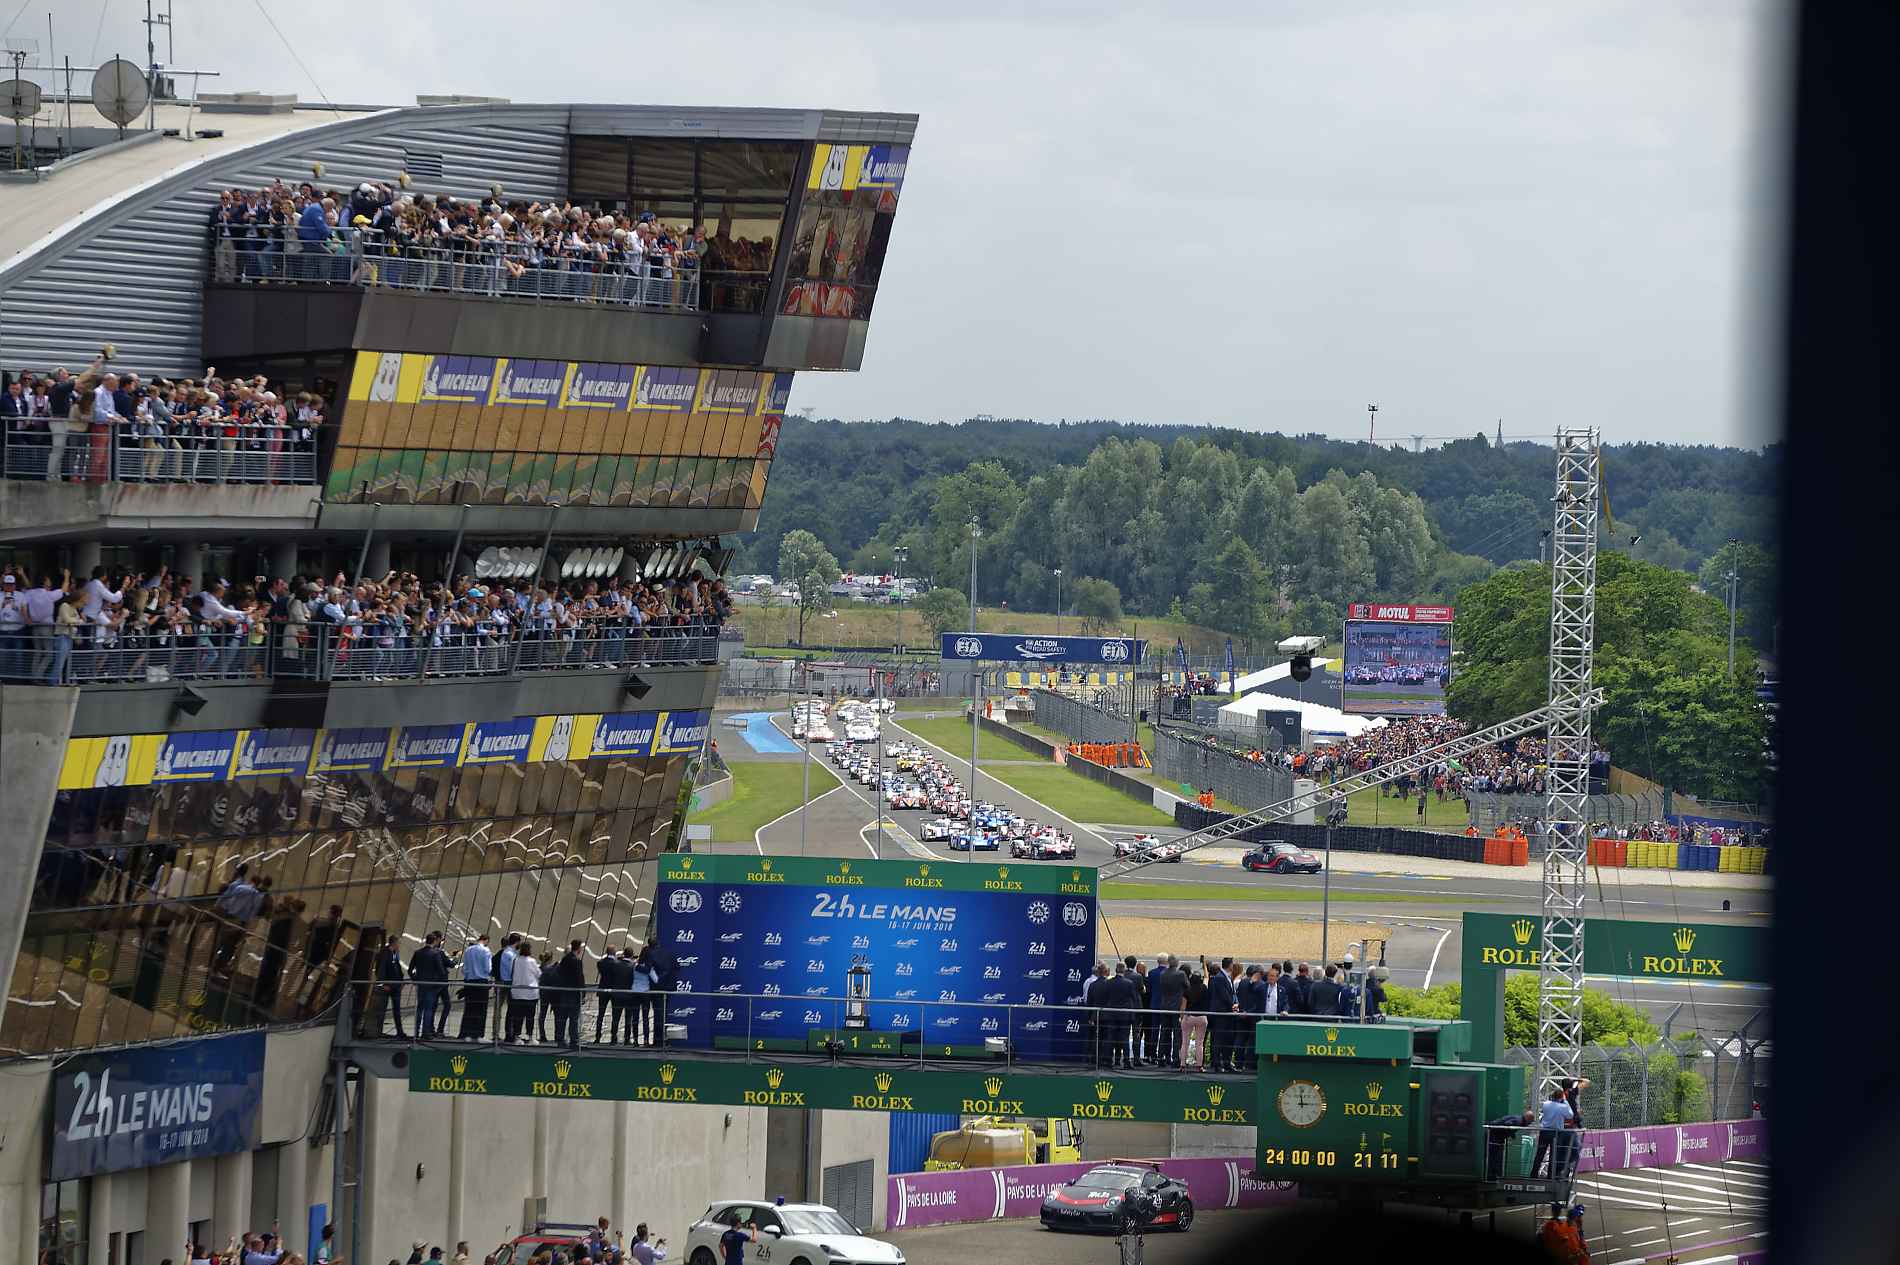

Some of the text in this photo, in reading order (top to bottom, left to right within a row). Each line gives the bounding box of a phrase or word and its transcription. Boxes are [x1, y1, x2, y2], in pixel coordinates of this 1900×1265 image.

[437, 374, 492, 392] MICHELIN
[511, 377, 561, 395] MICHELIN
[581, 380, 630, 398] MICHELIN
[650, 383, 696, 401] MICHELIN
[714, 386, 758, 404] MICHELIN
[1378, 607, 1410, 619] MOTUL
[480, 734, 531, 752] MICHELIN
[606, 729, 652, 746] MICHELIN
[332, 742, 387, 761] MICHELIN
[408, 738, 460, 756] MICHELIN
[172, 749, 231, 769] MICHELIN
[254, 745, 310, 765] MICHELIN
[667, 870, 705, 881] ROLEX
[747, 872, 784, 882] ROLEX
[826, 875, 864, 885] ROLEX
[905, 878, 943, 888] ROLEX
[984, 880, 1022, 890] ROLEX
[1061, 883, 1090, 893] ROLEX
[810, 892, 957, 922] 24h LE MANS
[888, 920, 953, 932] 16-17 JUIN 2018
[1482, 946, 1562, 967] ROLE
[1642, 956, 1724, 976] ROLEX
[756, 1040, 764, 1050] 2
[852, 1036, 858, 1048] 1
[945, 1046, 952, 1056] 3
[1306, 1044, 1357, 1058] ROLEX
[430, 1077, 488, 1093] ROLEX
[532, 1082, 592, 1098] ROLEX
[636, 1086, 698, 1101] ROLEX
[744, 1091, 806, 1106] ROLEX
[66, 1067, 214, 1142] 24h LE MANS
[852, 1095, 914, 1110] ROLEX
[963, 1100, 1024, 1114] ROLEX
[1072, 1104, 1136, 1119] ROLEX
[1183, 1108, 1248, 1123] ROLEX
[1344, 1103, 1404, 1118] ROLEX
[1354, 1152, 1399, 1169] 21 11
[1008, 1185, 1024, 1200] PAYS
[1026, 1184, 1036, 1199] DE
[1036, 1184, 1046, 1198] LA
[1240, 1178, 1257, 1191] PAYS
[908, 1190, 956, 1208] PAYS DE LA LOIRE
